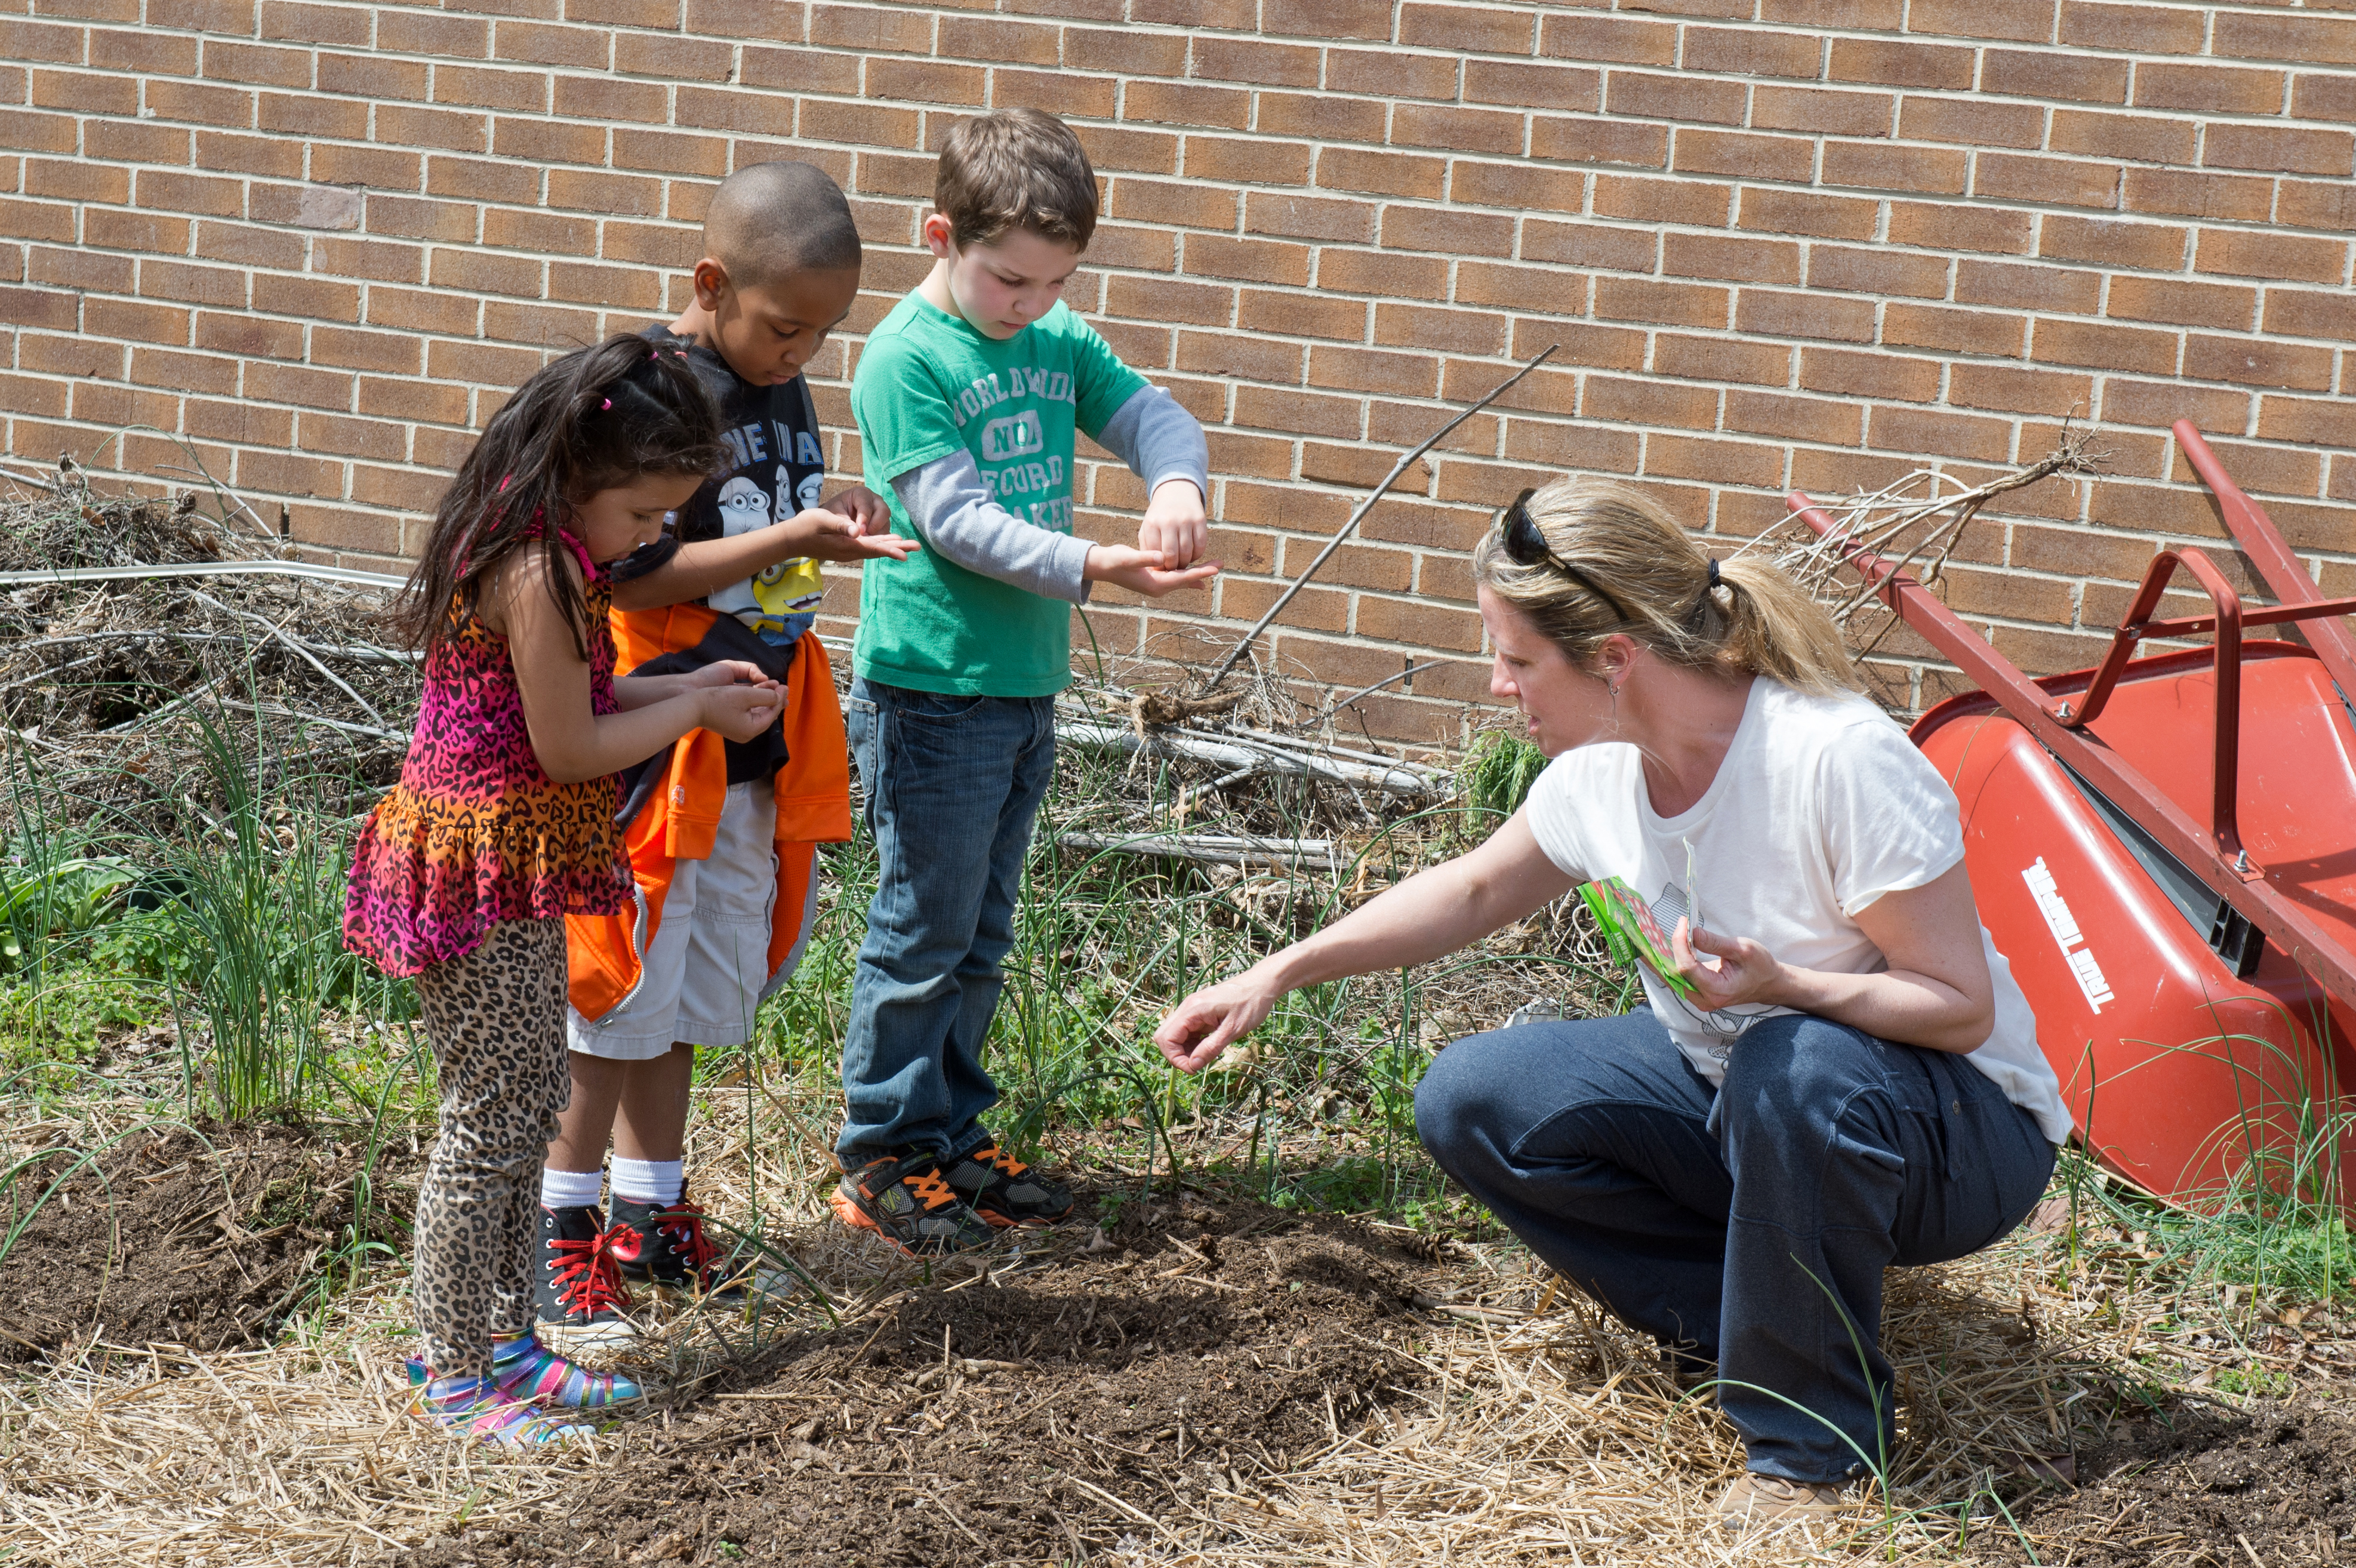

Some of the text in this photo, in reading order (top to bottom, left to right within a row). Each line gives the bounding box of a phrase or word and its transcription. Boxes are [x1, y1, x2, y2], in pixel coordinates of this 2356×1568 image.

[718, 423, 768, 470] NE
[981, 455, 1062, 496] ECORD
[1613, 931, 1631, 960] CARROT
[2021, 860, 2114, 1015] TRUE TEMPER
